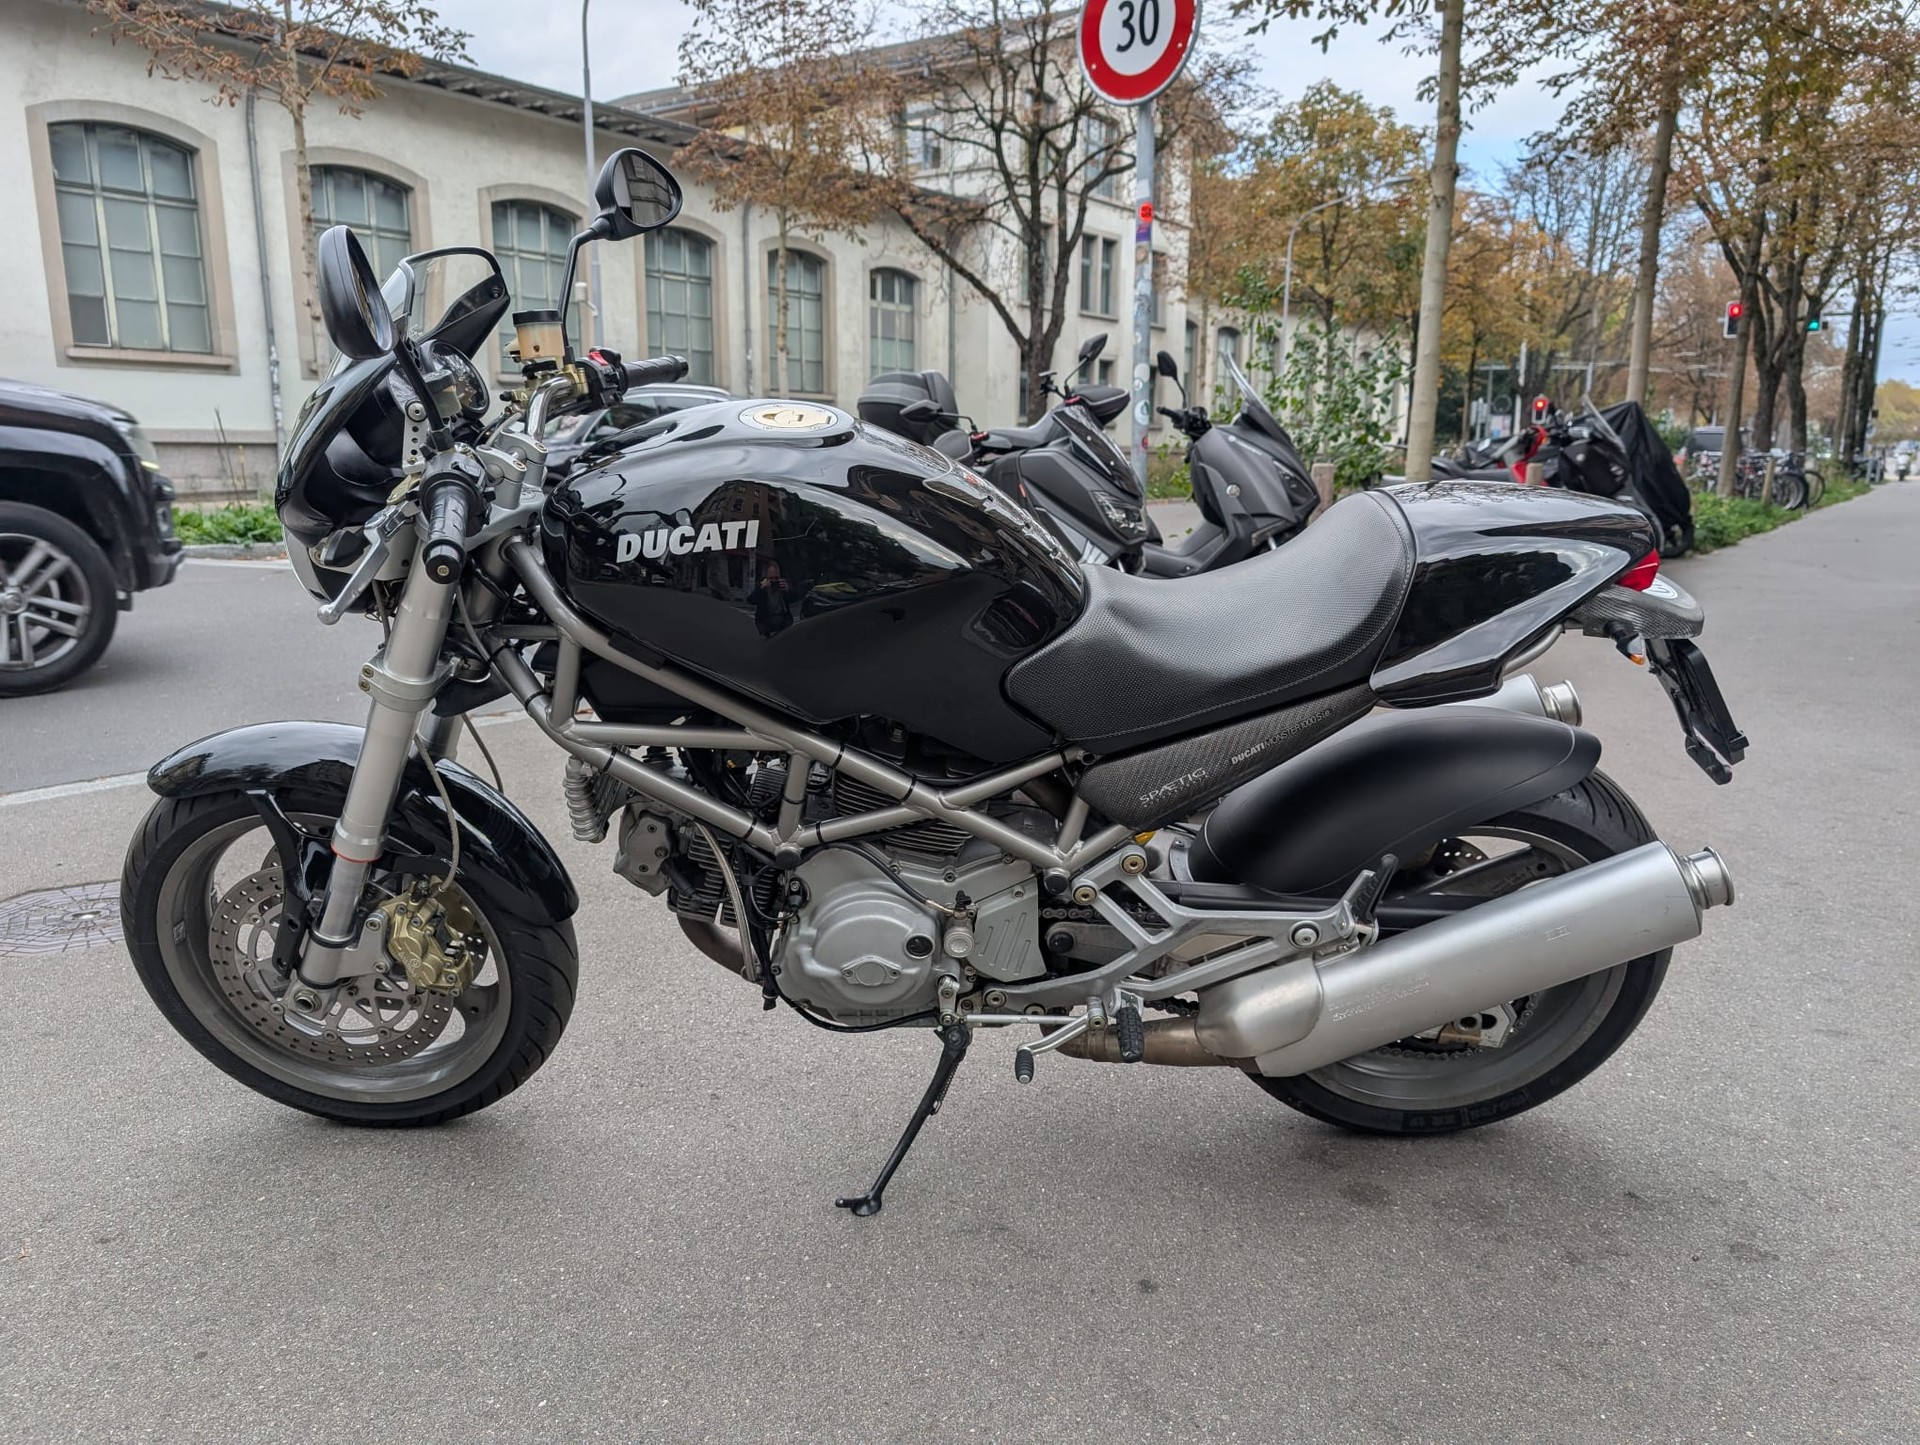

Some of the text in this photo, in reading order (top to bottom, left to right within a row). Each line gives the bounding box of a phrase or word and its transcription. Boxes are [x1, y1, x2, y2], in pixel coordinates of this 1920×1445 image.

[1116, 0, 1160, 52] 30
[616, 520, 760, 563] DUCATI
[1231, 742, 1266, 765] DUCATI
